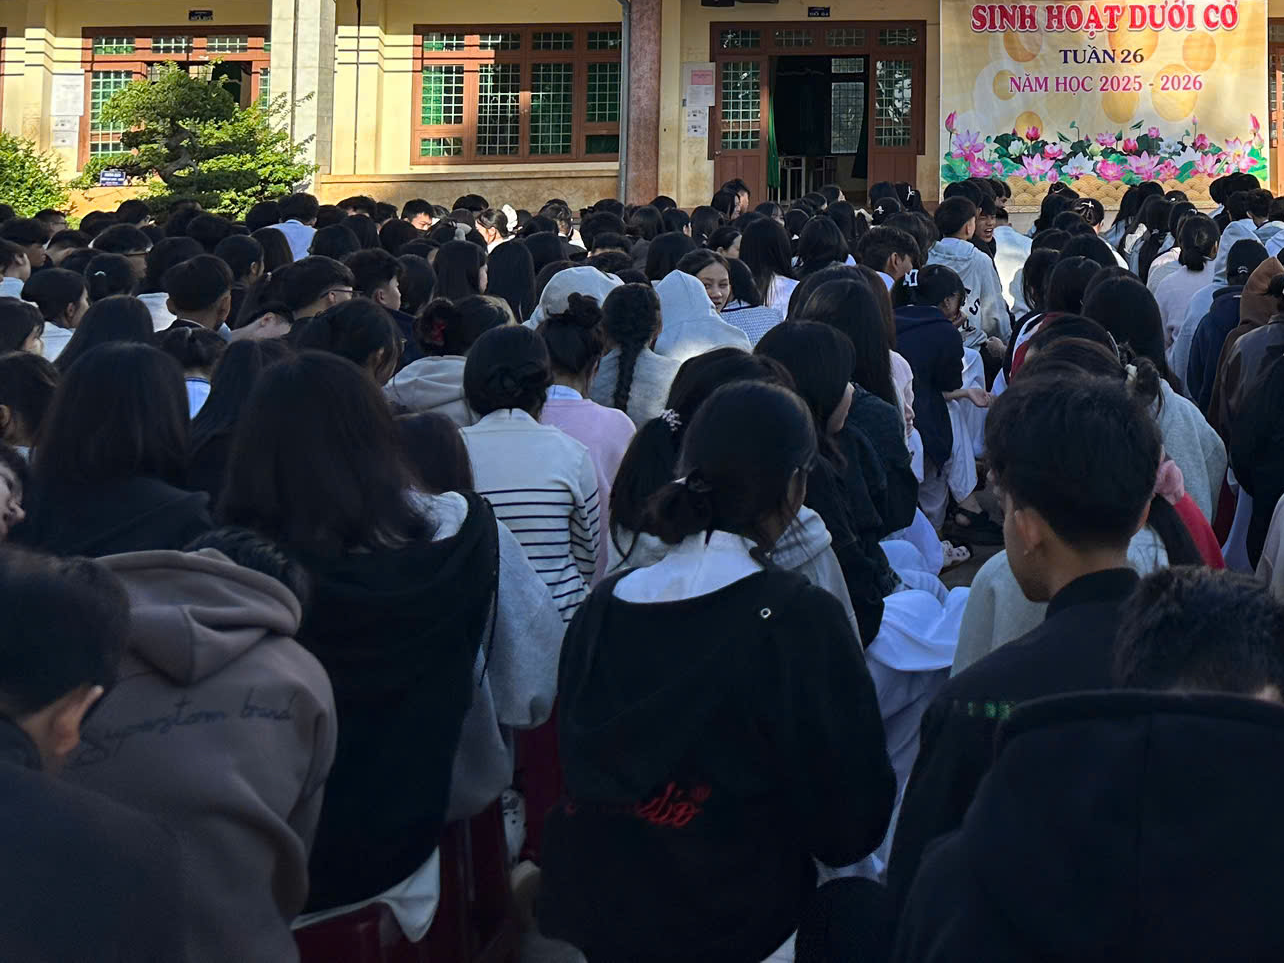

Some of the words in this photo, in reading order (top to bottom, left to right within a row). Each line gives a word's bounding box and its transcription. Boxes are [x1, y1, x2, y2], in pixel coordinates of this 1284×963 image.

[971, 4, 1038, 31] SINH
[1045, 4, 1124, 39] HOẠT
[1059, 44, 1116, 64] TUẦN
[1120, 48, 1144, 63] 26
[1009, 73, 1050, 92] NĂM
[1055, 76, 1093, 95] HỌC
[1099, 75, 1143, 92] 2025
[1160, 74, 1203, 91] 2026
